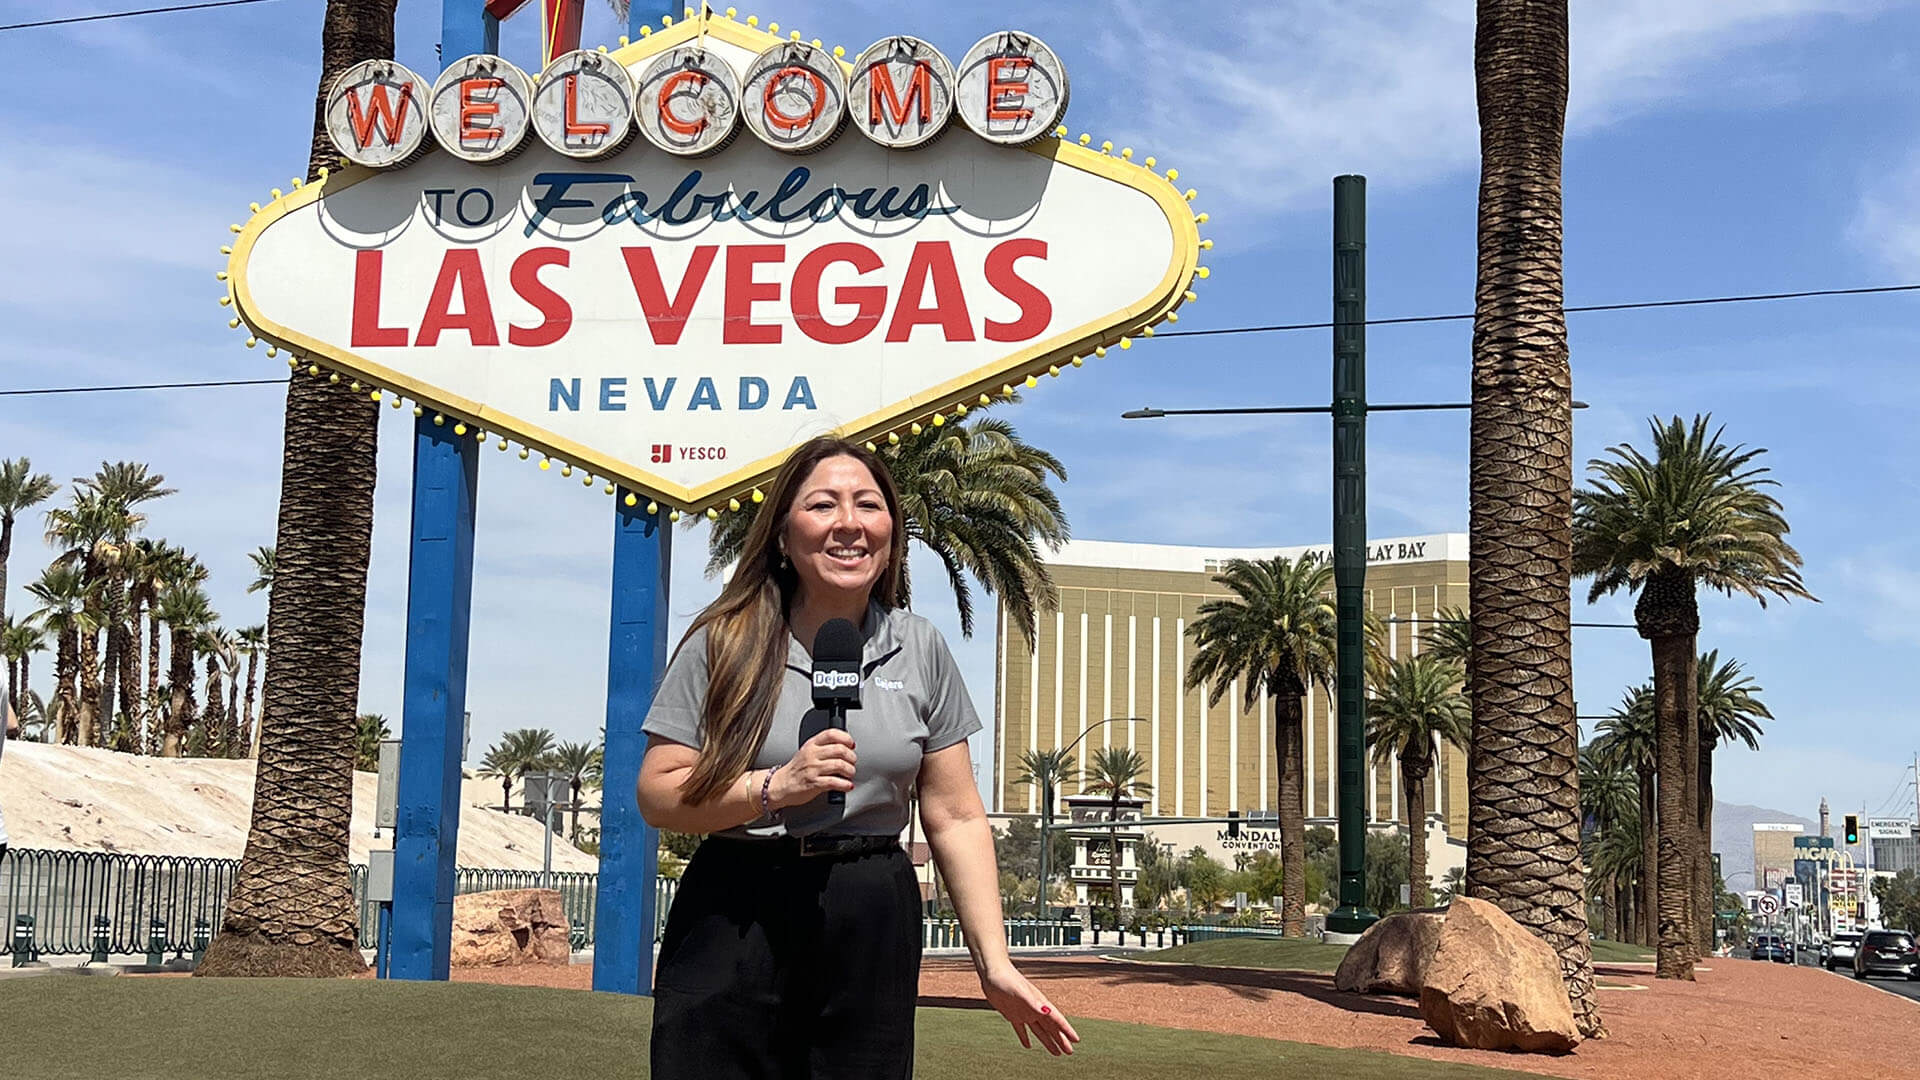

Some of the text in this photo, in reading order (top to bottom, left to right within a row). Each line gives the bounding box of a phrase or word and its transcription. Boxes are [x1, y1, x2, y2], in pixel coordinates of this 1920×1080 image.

[345, 55, 1034, 152] WELCOME
[424, 166, 961, 239] TO Fabulous
[350, 237, 1053, 348] LAS VEGAS
[548, 376, 818, 412] NEVADA
[679, 446, 727, 461] YESCO
[1311, 542, 1426, 565] MALAY BAY
[814, 671, 858, 689] Dejero
[1794, 847, 1835, 860] MGM
